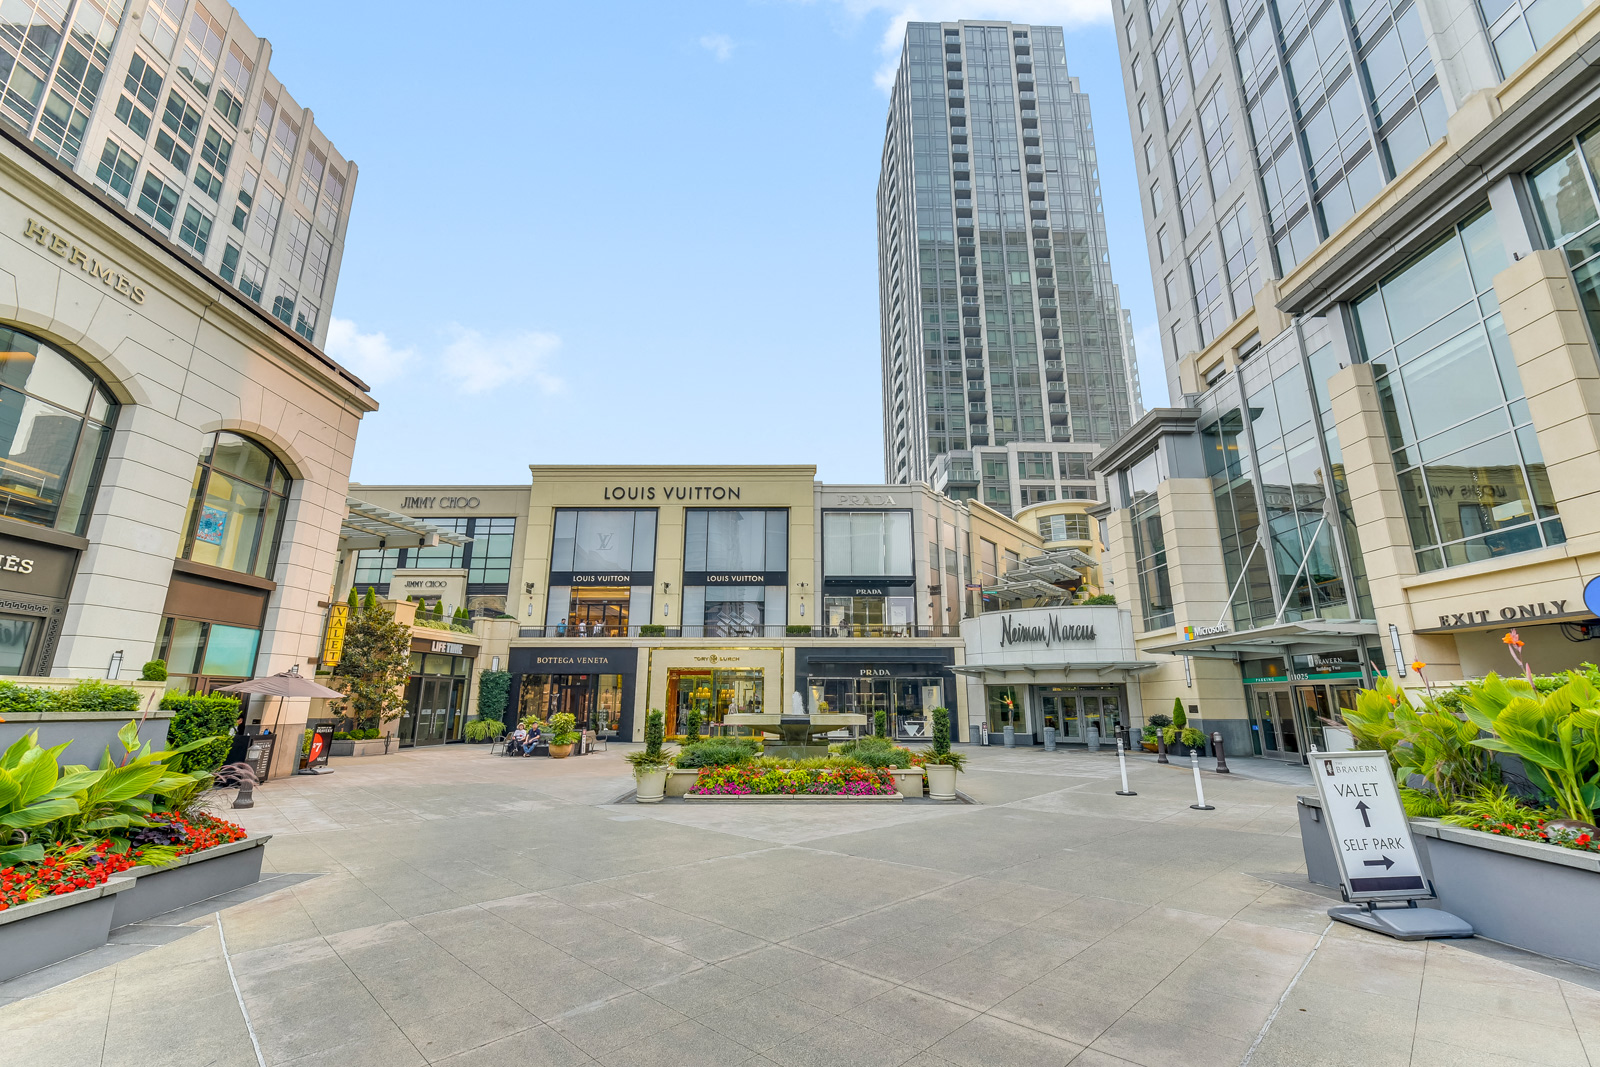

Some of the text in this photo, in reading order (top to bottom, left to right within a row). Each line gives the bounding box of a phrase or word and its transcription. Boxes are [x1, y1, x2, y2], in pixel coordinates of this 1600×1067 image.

[23, 217, 147, 305] HERMÈS
[604, 486, 740, 500] LOUIS VUITTON
[837, 495, 896, 505] PRADA
[401, 496, 480, 509] JIMMY CHOO
[1438, 599, 1567, 628] EXIT ONLY
[330, 607, 346, 660] VALET
[1000, 613, 1097, 648] Neiman Marcus
[1193, 623, 1226, 637] Microsoft
[431, 640, 464, 655] LIFE TIME
[1314, 657, 1343, 666] BRAVERN
[1291, 673, 1309, 681] 11025
[1335, 765, 1378, 774] BRAVERN
[1334, 782, 1379, 798] VALET
[1343, 837, 1405, 852] SELF PARK
